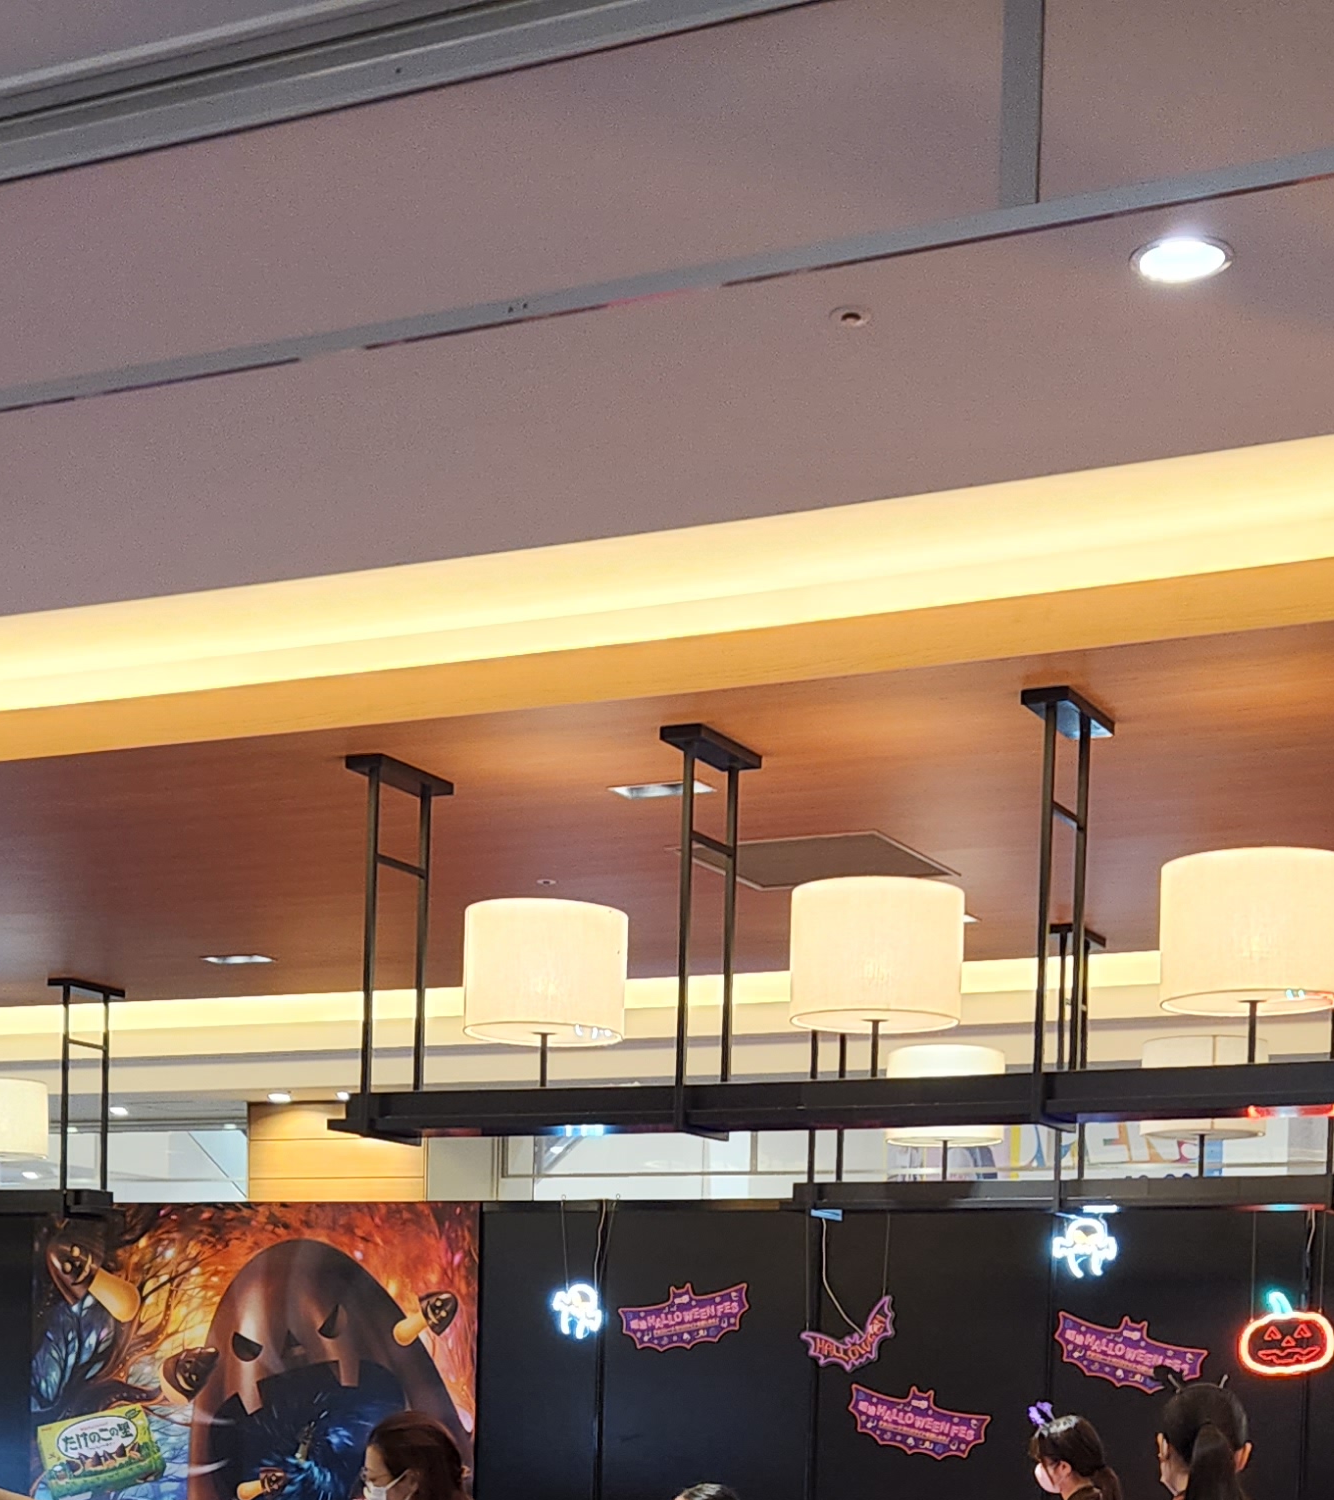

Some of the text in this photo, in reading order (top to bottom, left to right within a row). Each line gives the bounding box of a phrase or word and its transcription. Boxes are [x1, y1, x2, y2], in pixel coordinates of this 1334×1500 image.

[62, 1421, 134, 1452] たけのこの里
